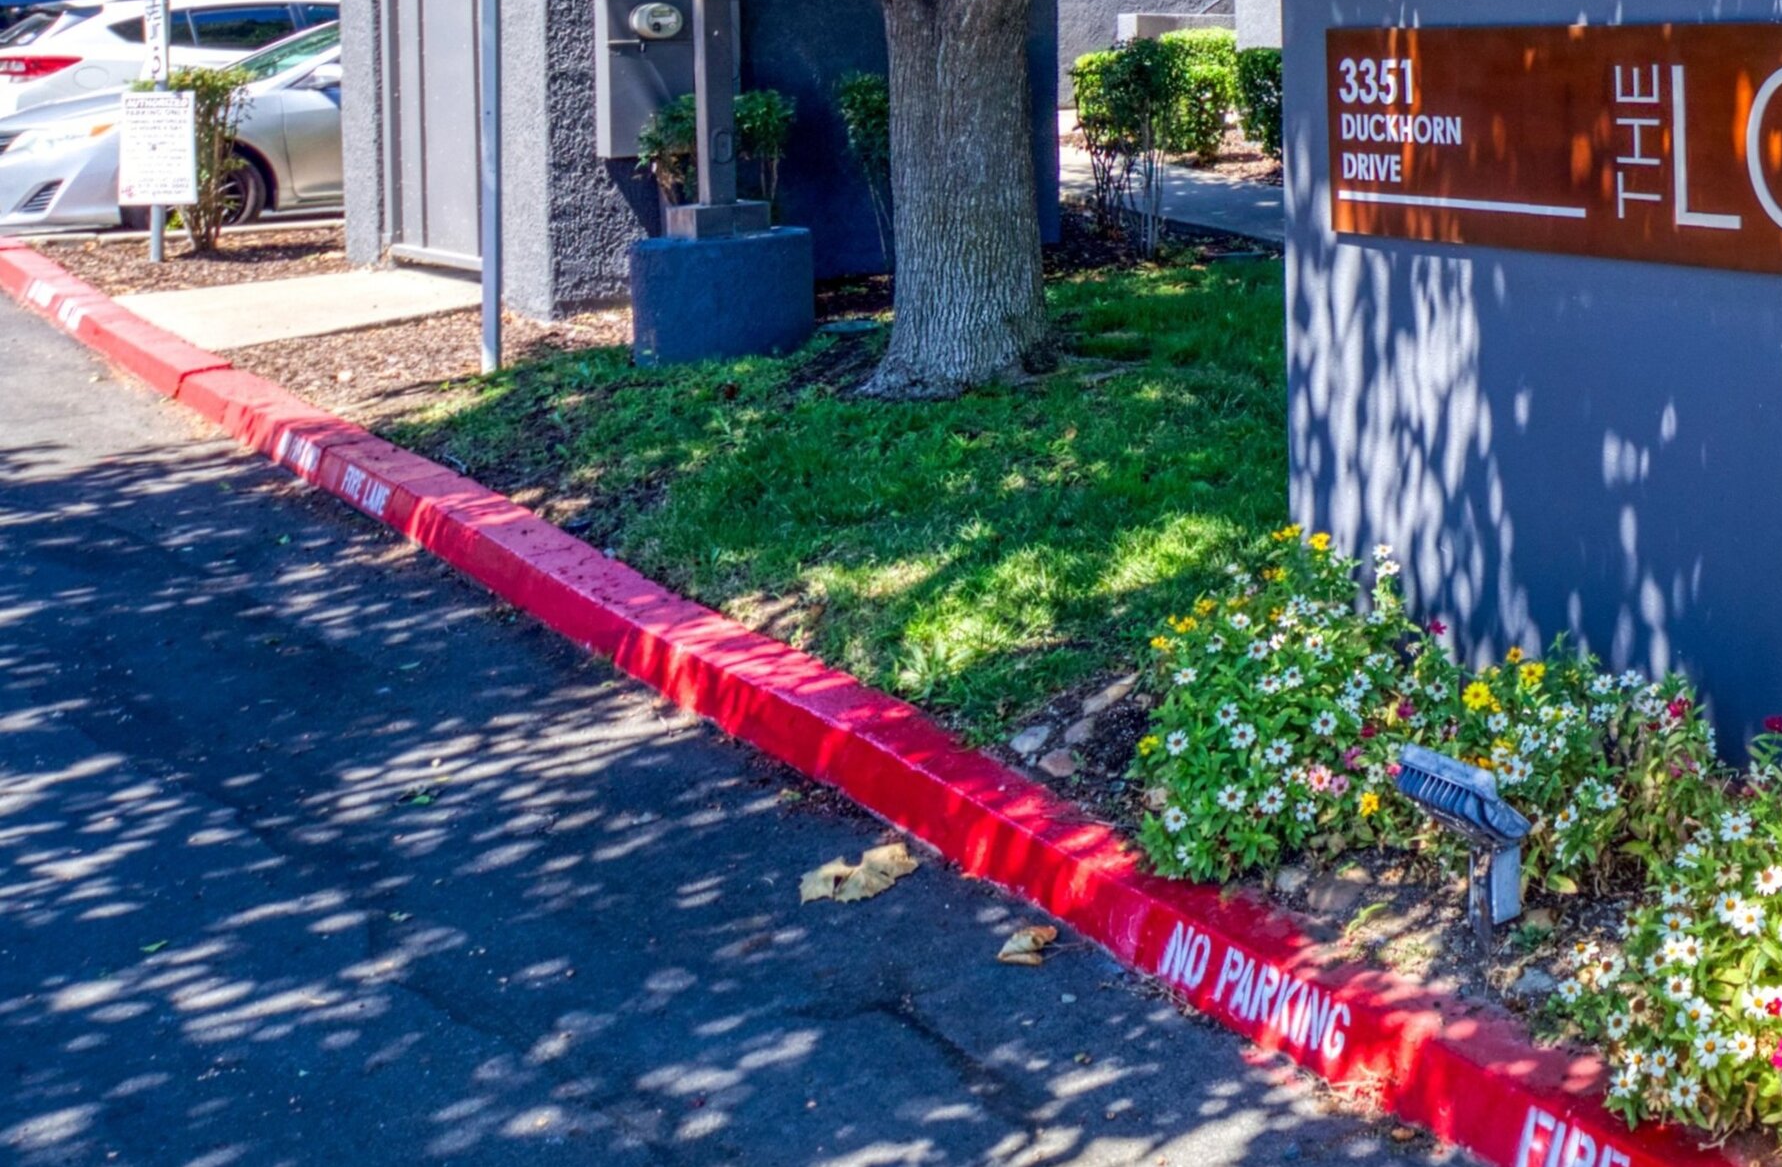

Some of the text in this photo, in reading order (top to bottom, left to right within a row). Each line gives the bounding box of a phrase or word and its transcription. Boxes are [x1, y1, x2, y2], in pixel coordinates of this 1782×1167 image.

[1339, 57, 1414, 105] 3351
[1341, 113, 1462, 145] DUCKHORN
[1615, 64, 1662, 219] THE
[1342, 152, 1402, 183] DRIVE
[341, 464, 391, 516] FIRE LANE
[1160, 920, 1351, 1060] NO PARKING
